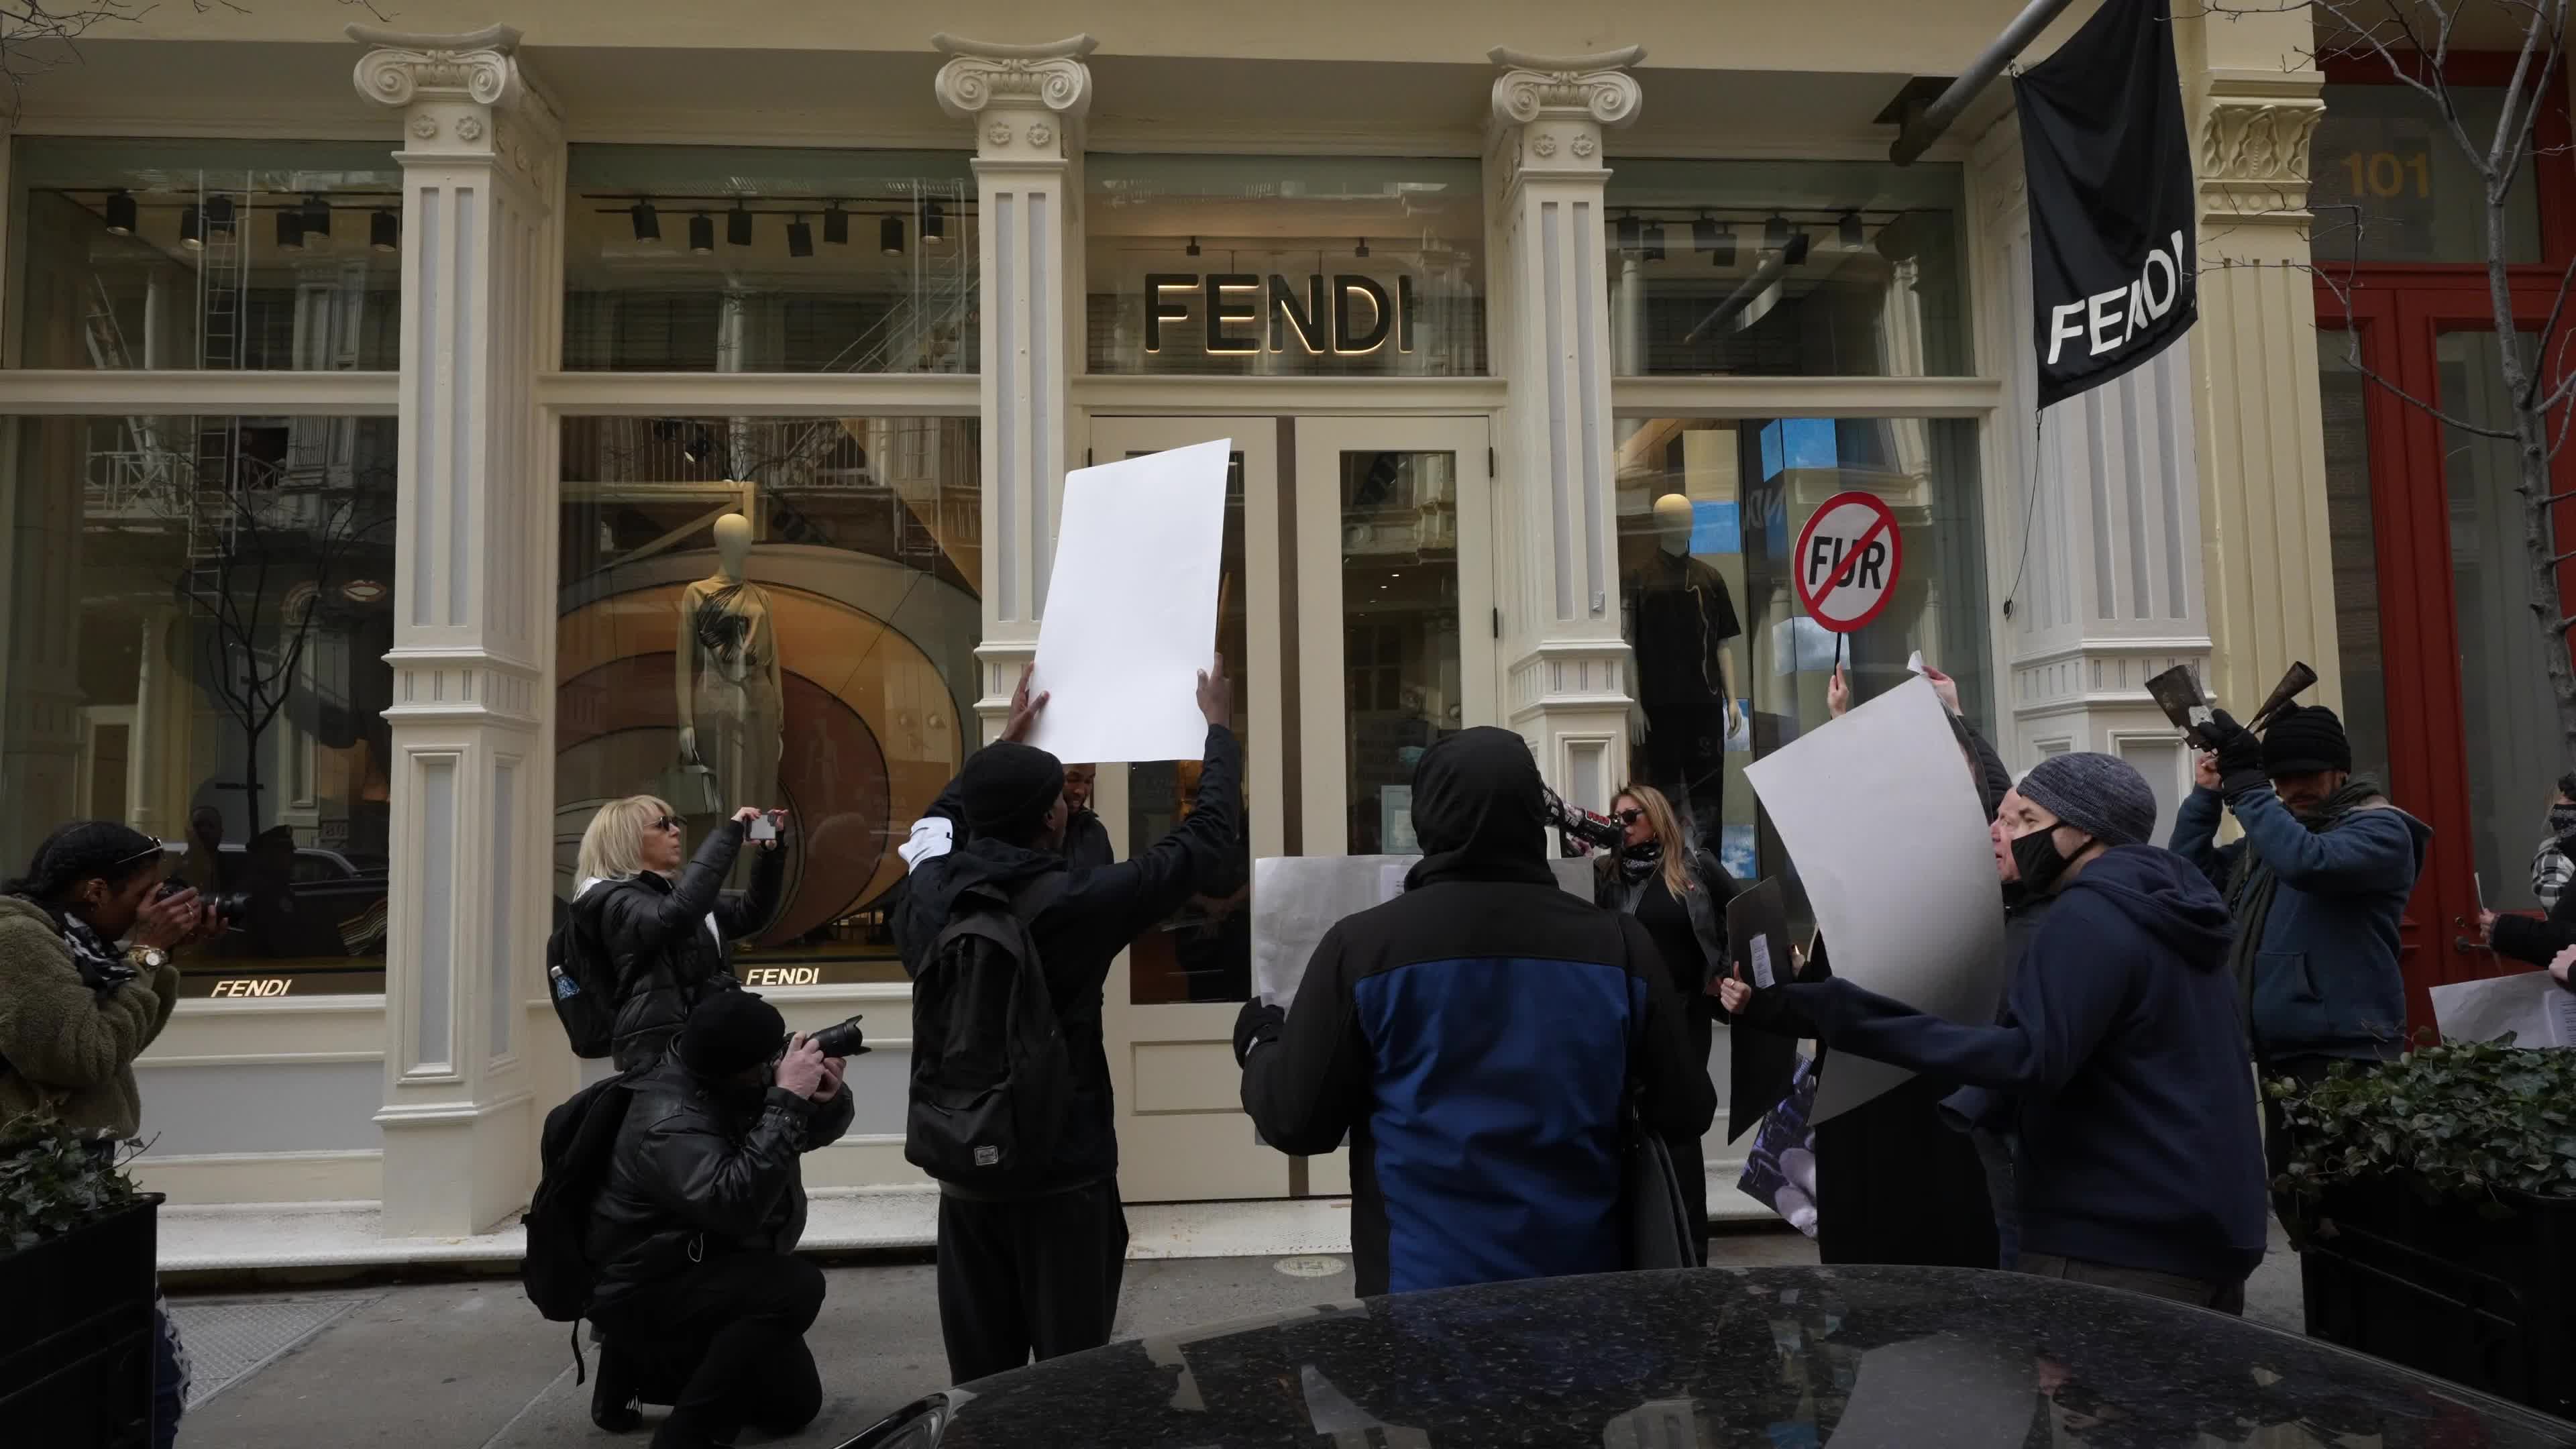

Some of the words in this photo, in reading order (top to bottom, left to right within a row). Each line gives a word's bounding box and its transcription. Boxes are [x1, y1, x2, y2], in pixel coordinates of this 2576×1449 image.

[2341, 152, 2430, 199] 101
[1144, 274, 1414, 354] FENDI
[1808, 535, 1886, 590] FUR
[209, 979, 292, 998] FENDI
[746, 967, 819, 985] FENDI
